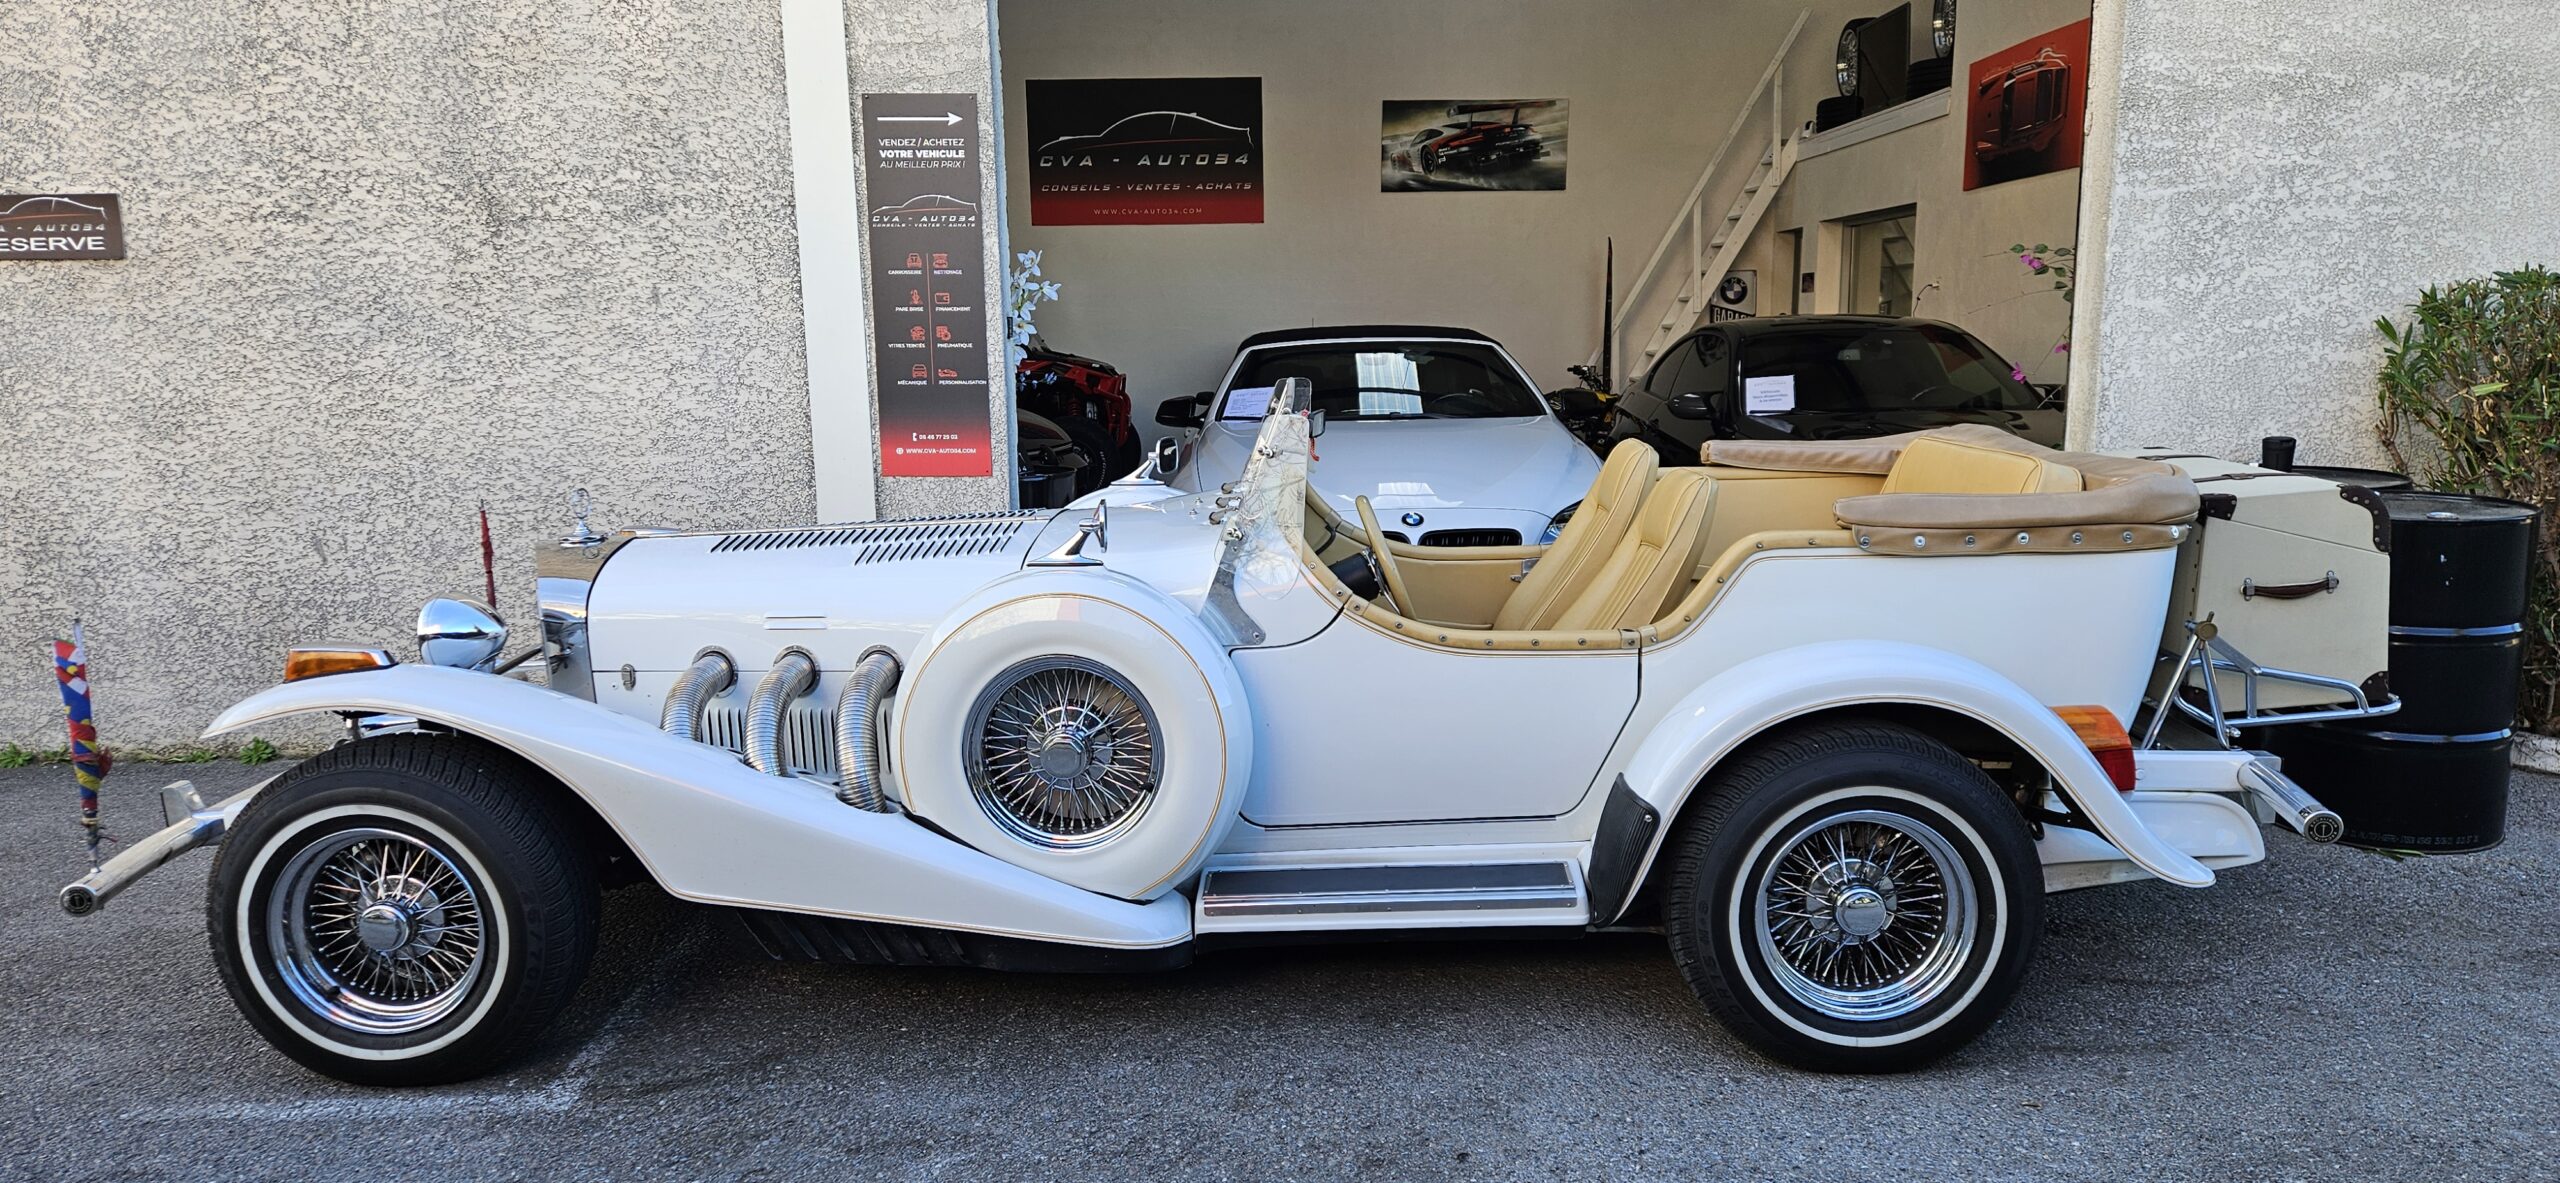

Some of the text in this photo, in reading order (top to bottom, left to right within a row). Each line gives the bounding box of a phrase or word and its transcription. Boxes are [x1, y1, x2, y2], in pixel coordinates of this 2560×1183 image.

[878, 138, 916, 147] VENDEZ
[922, 138, 965, 147] ACHETEZ
[879, 150, 966, 158] VOTRE VEHICULE
[880, 160, 894, 168] AU
[895, 160, 940, 168] MEILLEUR
[941, 160, 961, 168] PRIX
[1039, 155, 1094, 167] CVA
[1138, 154, 1250, 166] AUTO34
[1041, 183, 1112, 192] CONSEILS
[1126, 183, 1181, 191] VENTES
[1195, 182, 1253, 190] ACHATS
[33, 224, 106, 232] AUTO34
[0, 236, 106, 252] ESERVE
